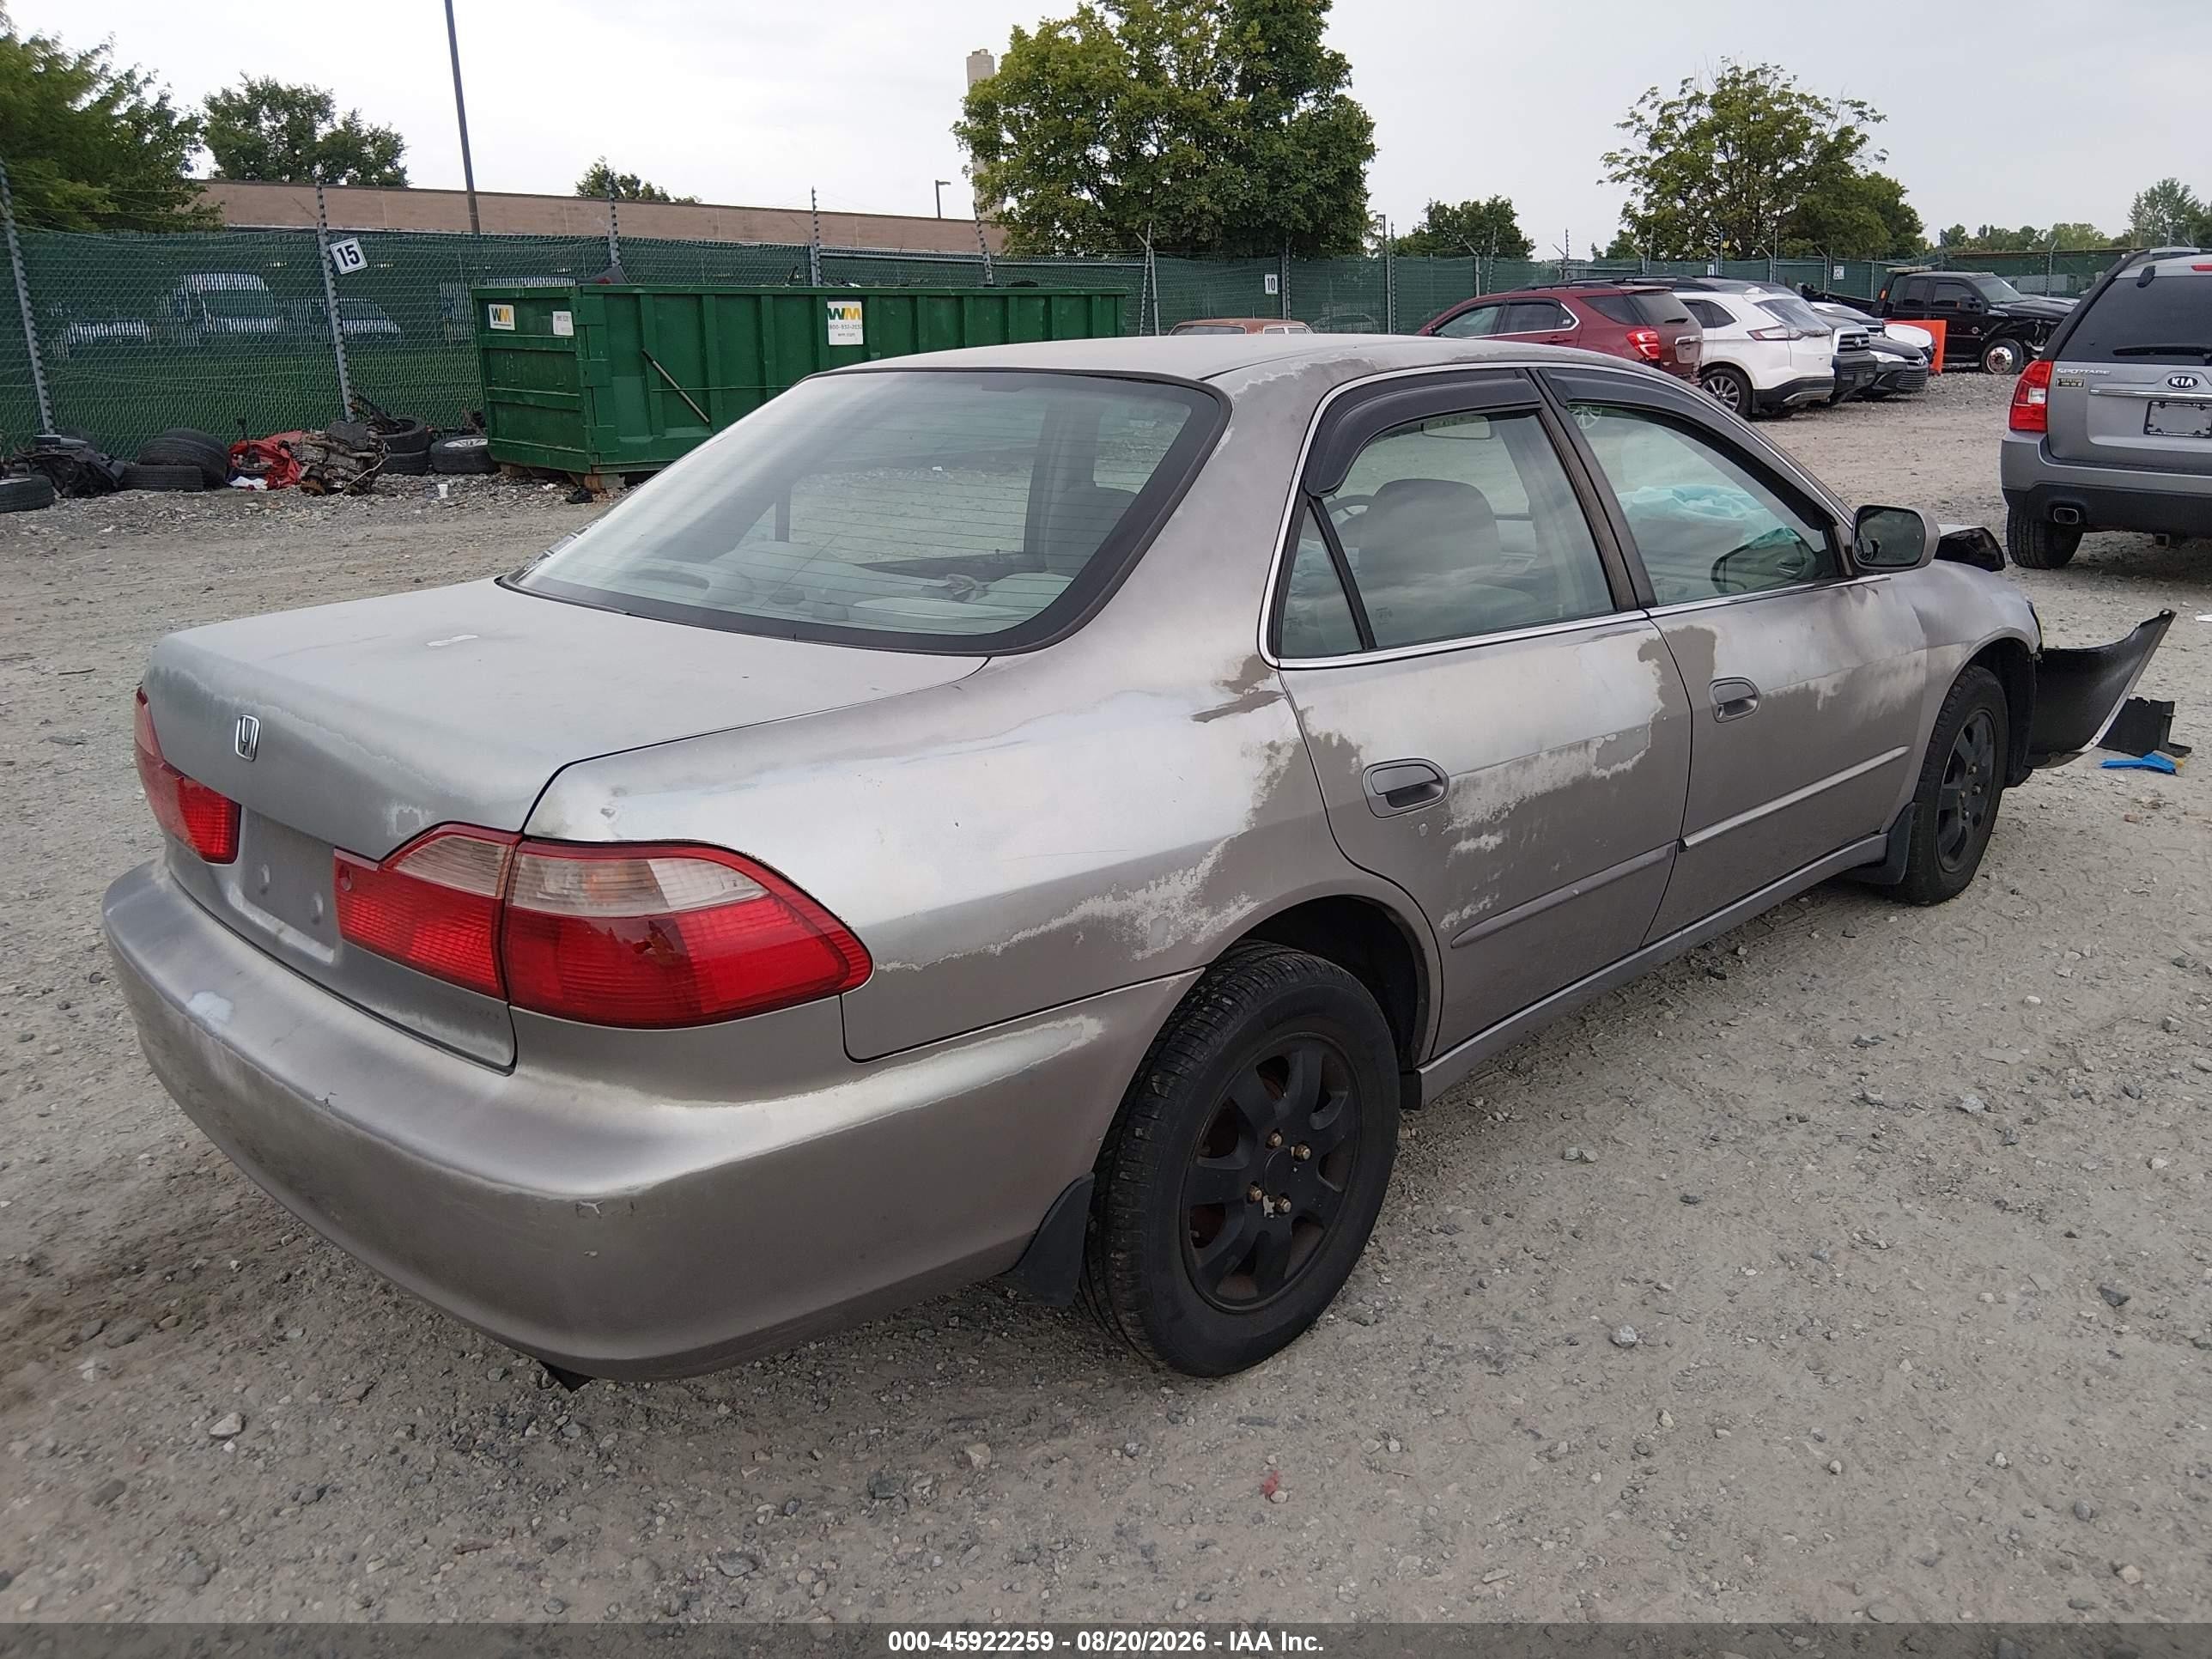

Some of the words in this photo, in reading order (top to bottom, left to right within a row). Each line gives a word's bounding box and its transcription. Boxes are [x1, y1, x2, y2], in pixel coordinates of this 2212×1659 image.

[337, 245, 360, 267] 15
[1267, 277, 1276, 291] 10
[491, 307, 510, 322] WM
[826, 307, 861, 320] WM
[2171, 377, 2194, 387] KIA
